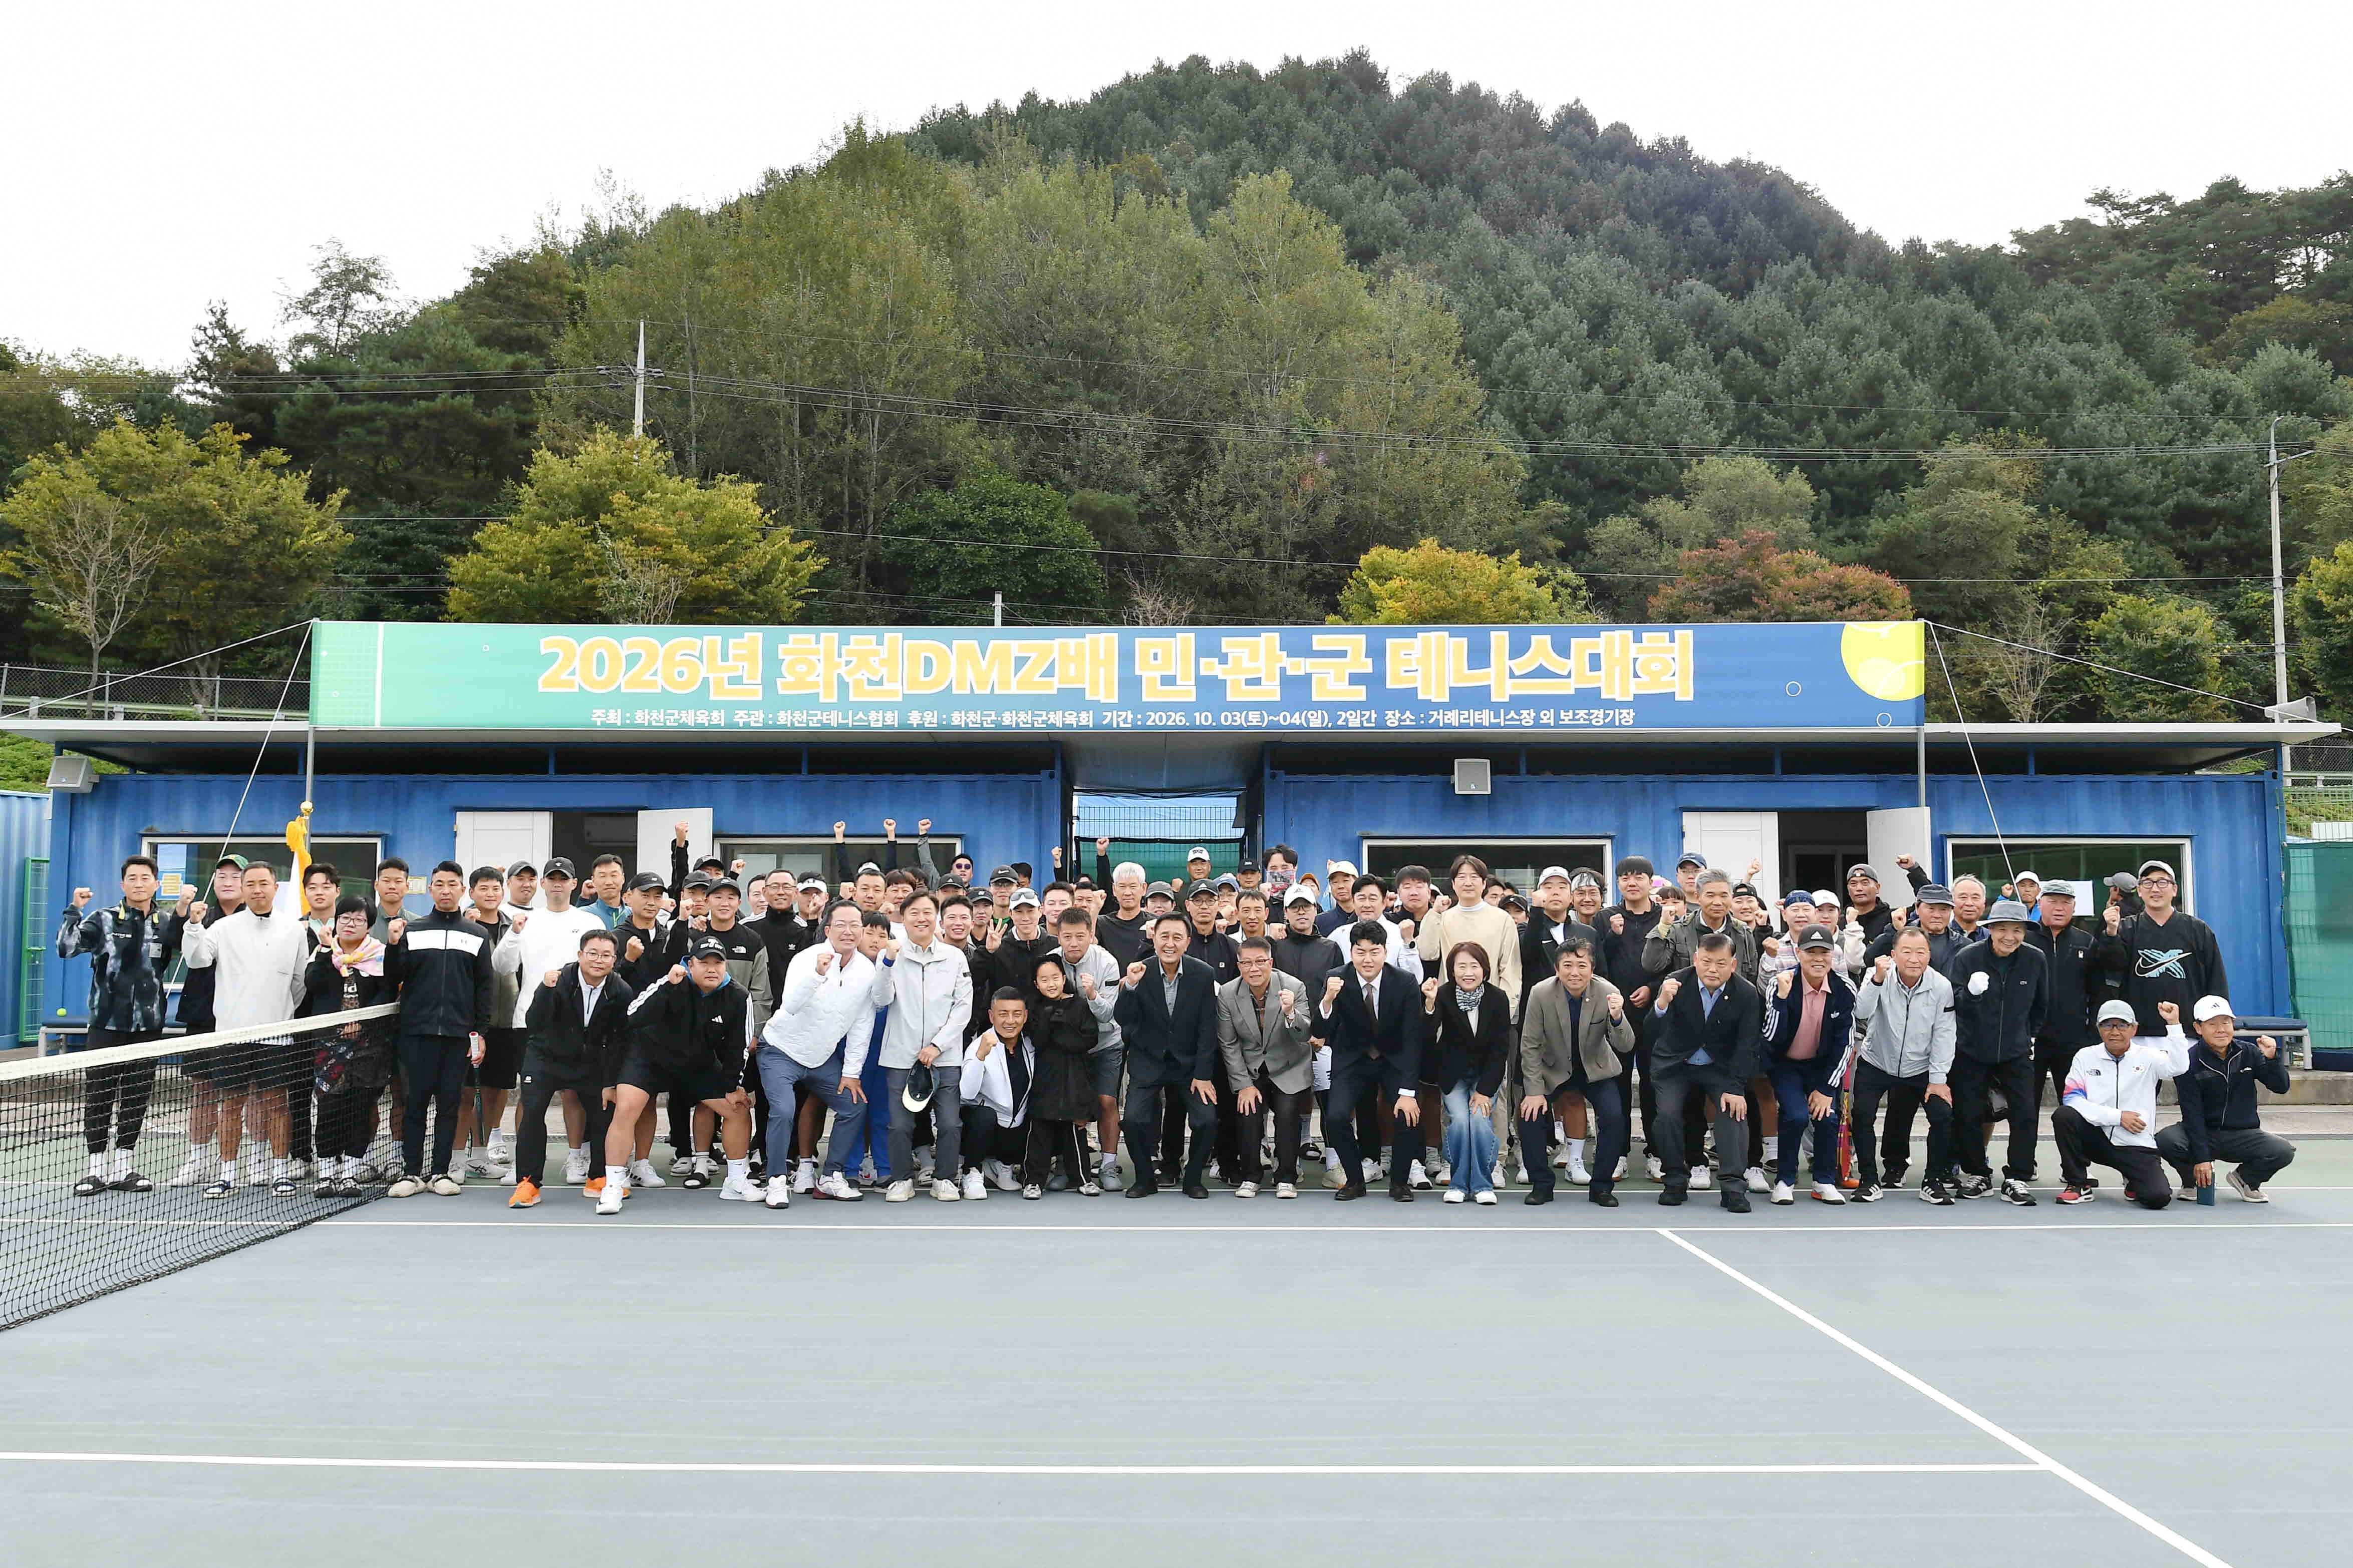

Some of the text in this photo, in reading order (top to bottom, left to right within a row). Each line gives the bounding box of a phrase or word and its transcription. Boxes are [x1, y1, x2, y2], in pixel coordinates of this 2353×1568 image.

[538, 630, 1694, 703] 2026년 화천DMZ배 민·관·군 테니스대회
[592, 709, 622, 726] 주최
[634, 709, 725, 726] 화천군체육회
[733, 710, 764, 727] 주관
[777, 710, 898, 727] 화천군테니스협회
[907, 710, 938, 727] 후원
[1102, 710, 1133, 728] 기간
[1146, 711, 1190, 726] 2026.
[1194, 711, 1216, 726] 10.
[1337, 710, 1377, 727] 2일간
[1384, 709, 1416, 727] 장소
[1428, 709, 1536, 727] 거례리테니스장
[1540, 709, 1554, 726] 외
[1559, 709, 1635, 726] 보조경기장
